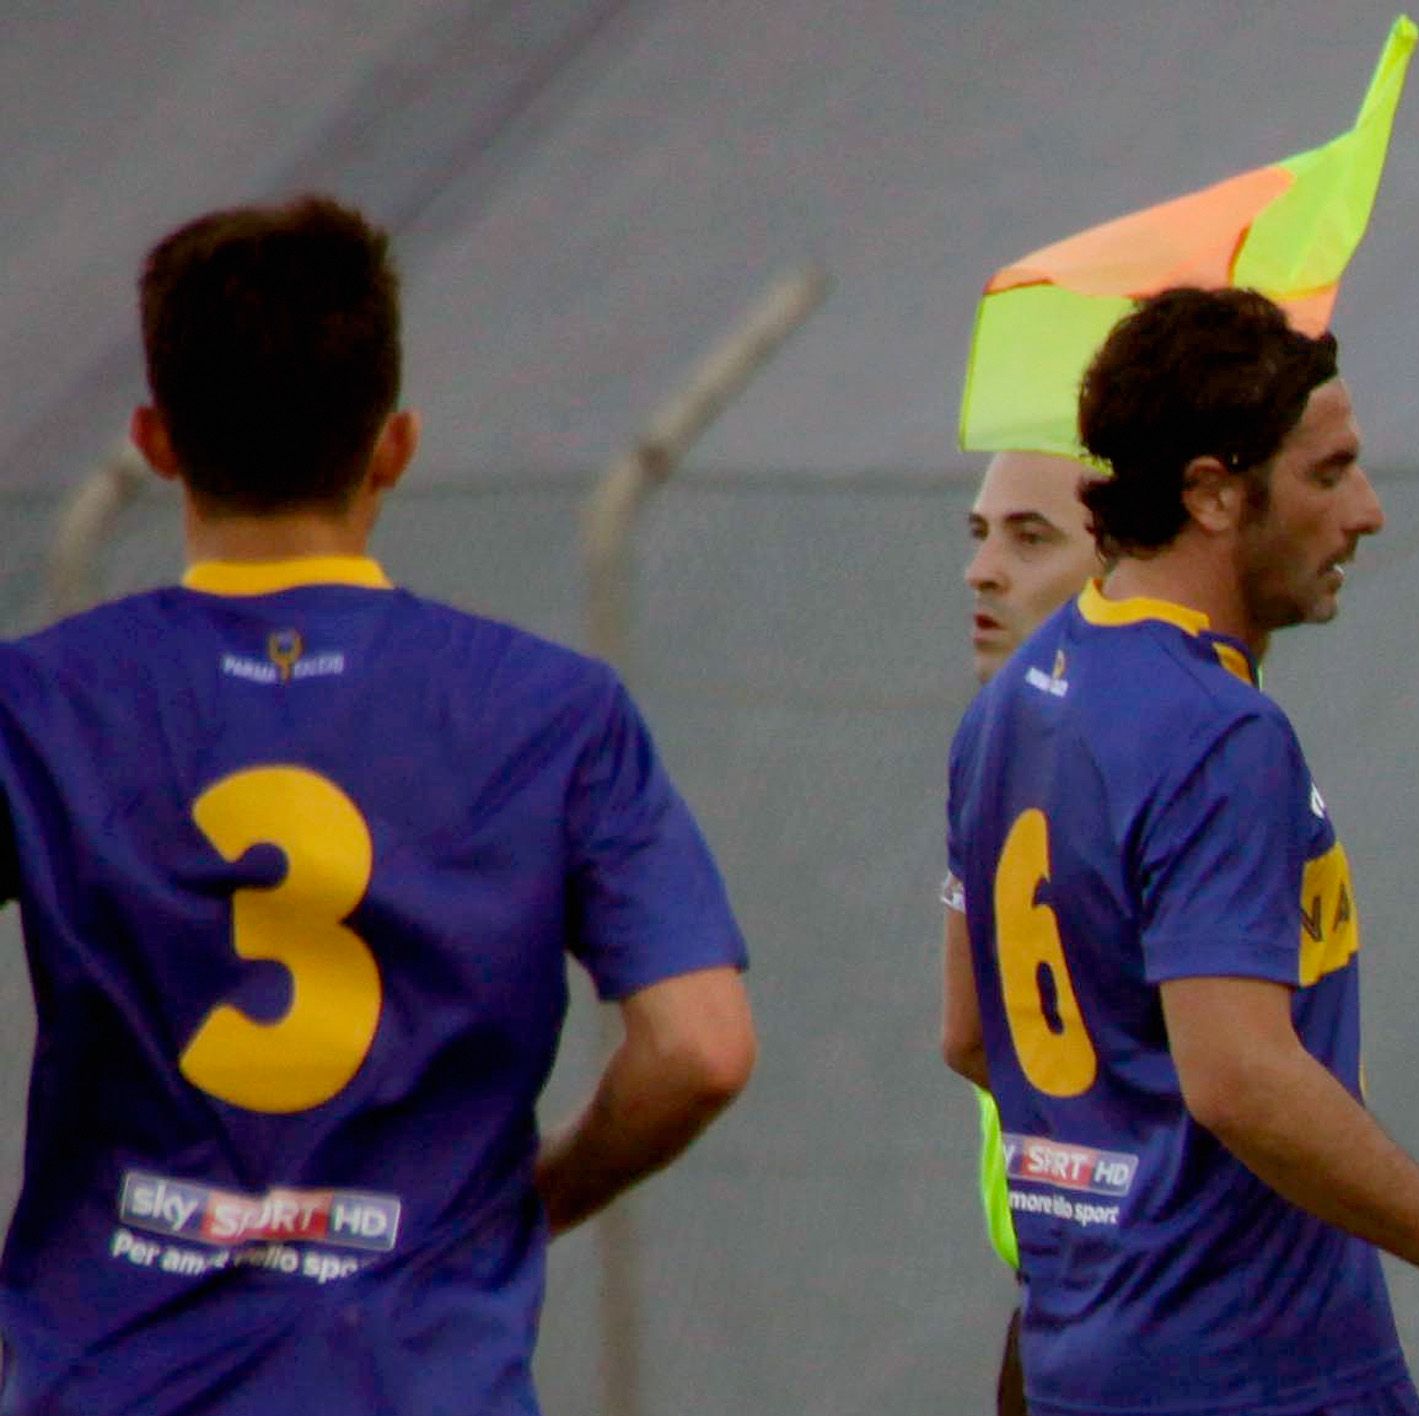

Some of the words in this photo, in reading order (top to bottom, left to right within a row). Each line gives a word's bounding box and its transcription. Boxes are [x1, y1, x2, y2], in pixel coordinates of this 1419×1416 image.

[179, 763, 384, 1114] 3
[993, 807, 1098, 1097] 6
[1093, 1161, 1130, 1187] HD
[130, 1180, 201, 1232] sky
[332, 1203, 388, 1237] HD
[112, 1228, 160, 1267] Per
